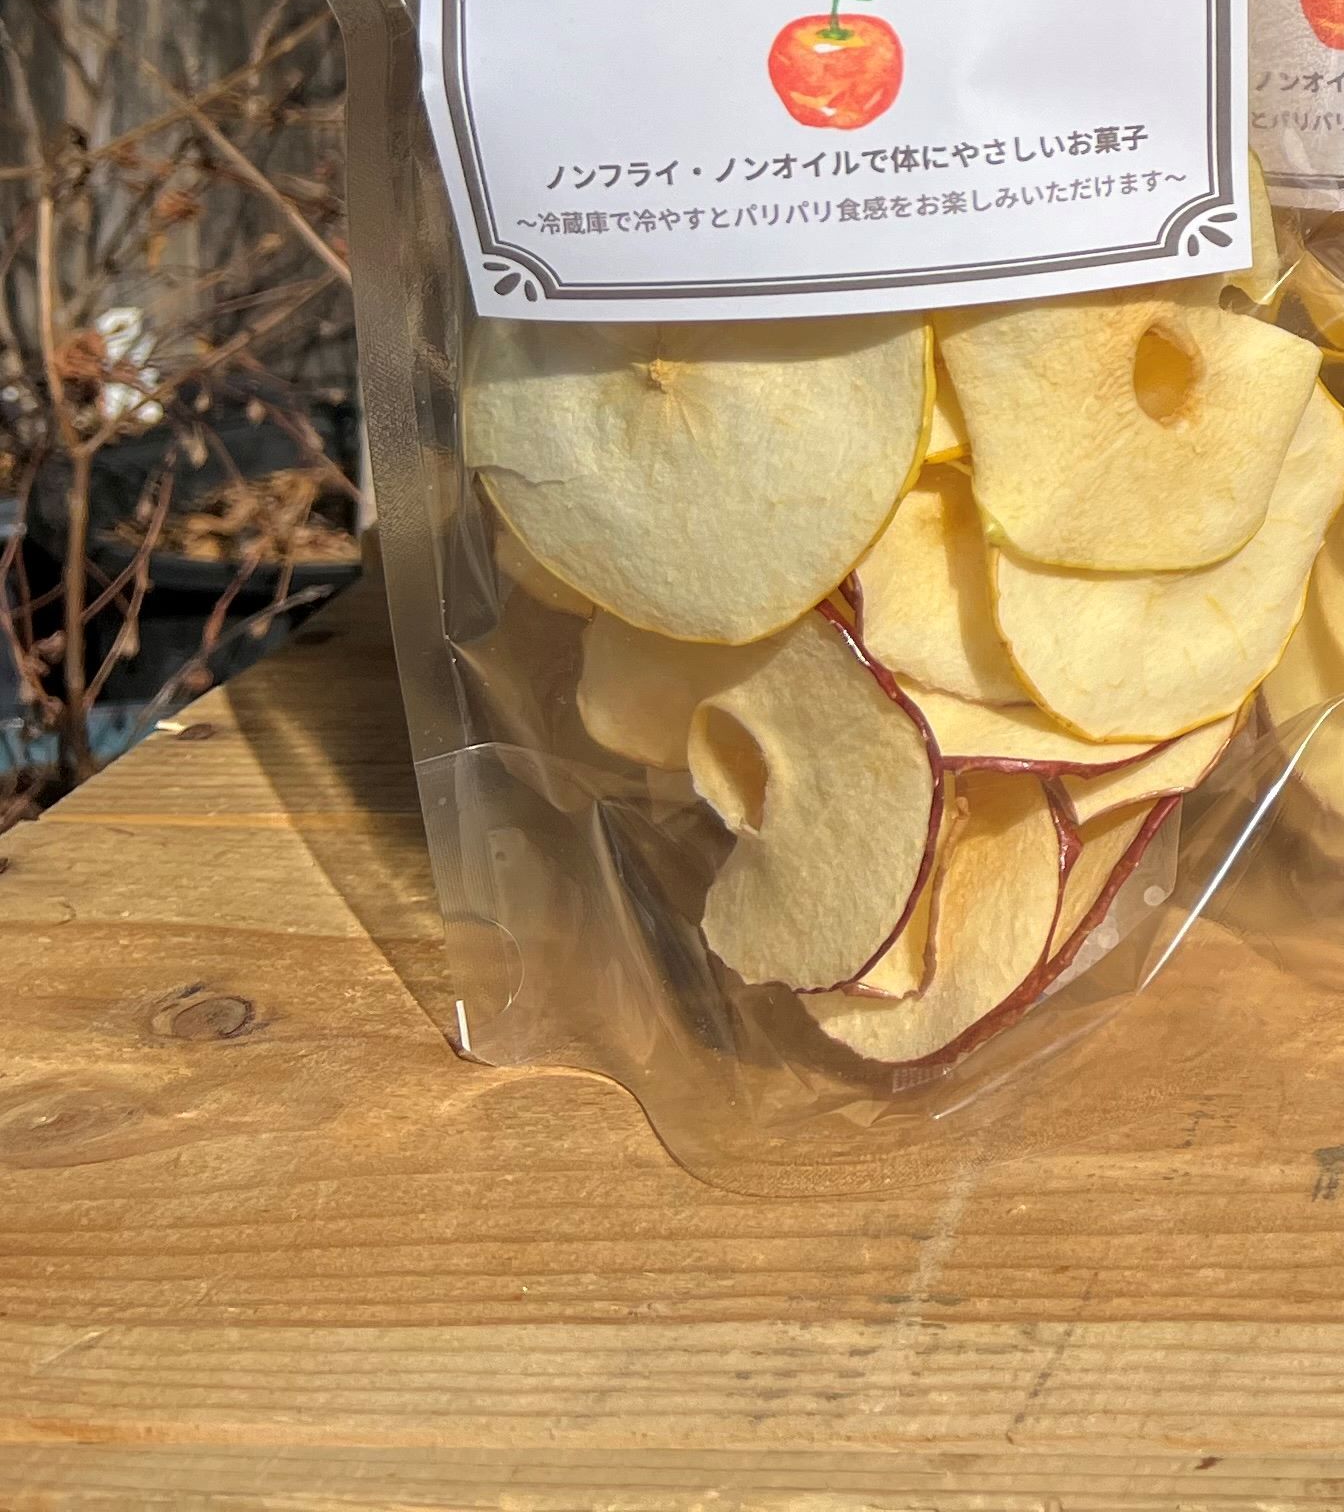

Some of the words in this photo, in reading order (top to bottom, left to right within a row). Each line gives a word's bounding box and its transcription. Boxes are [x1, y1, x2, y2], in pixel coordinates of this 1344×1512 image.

[546, 124, 1150, 190] ノンフライ・ノンオイルで体にやさしいお菓子
